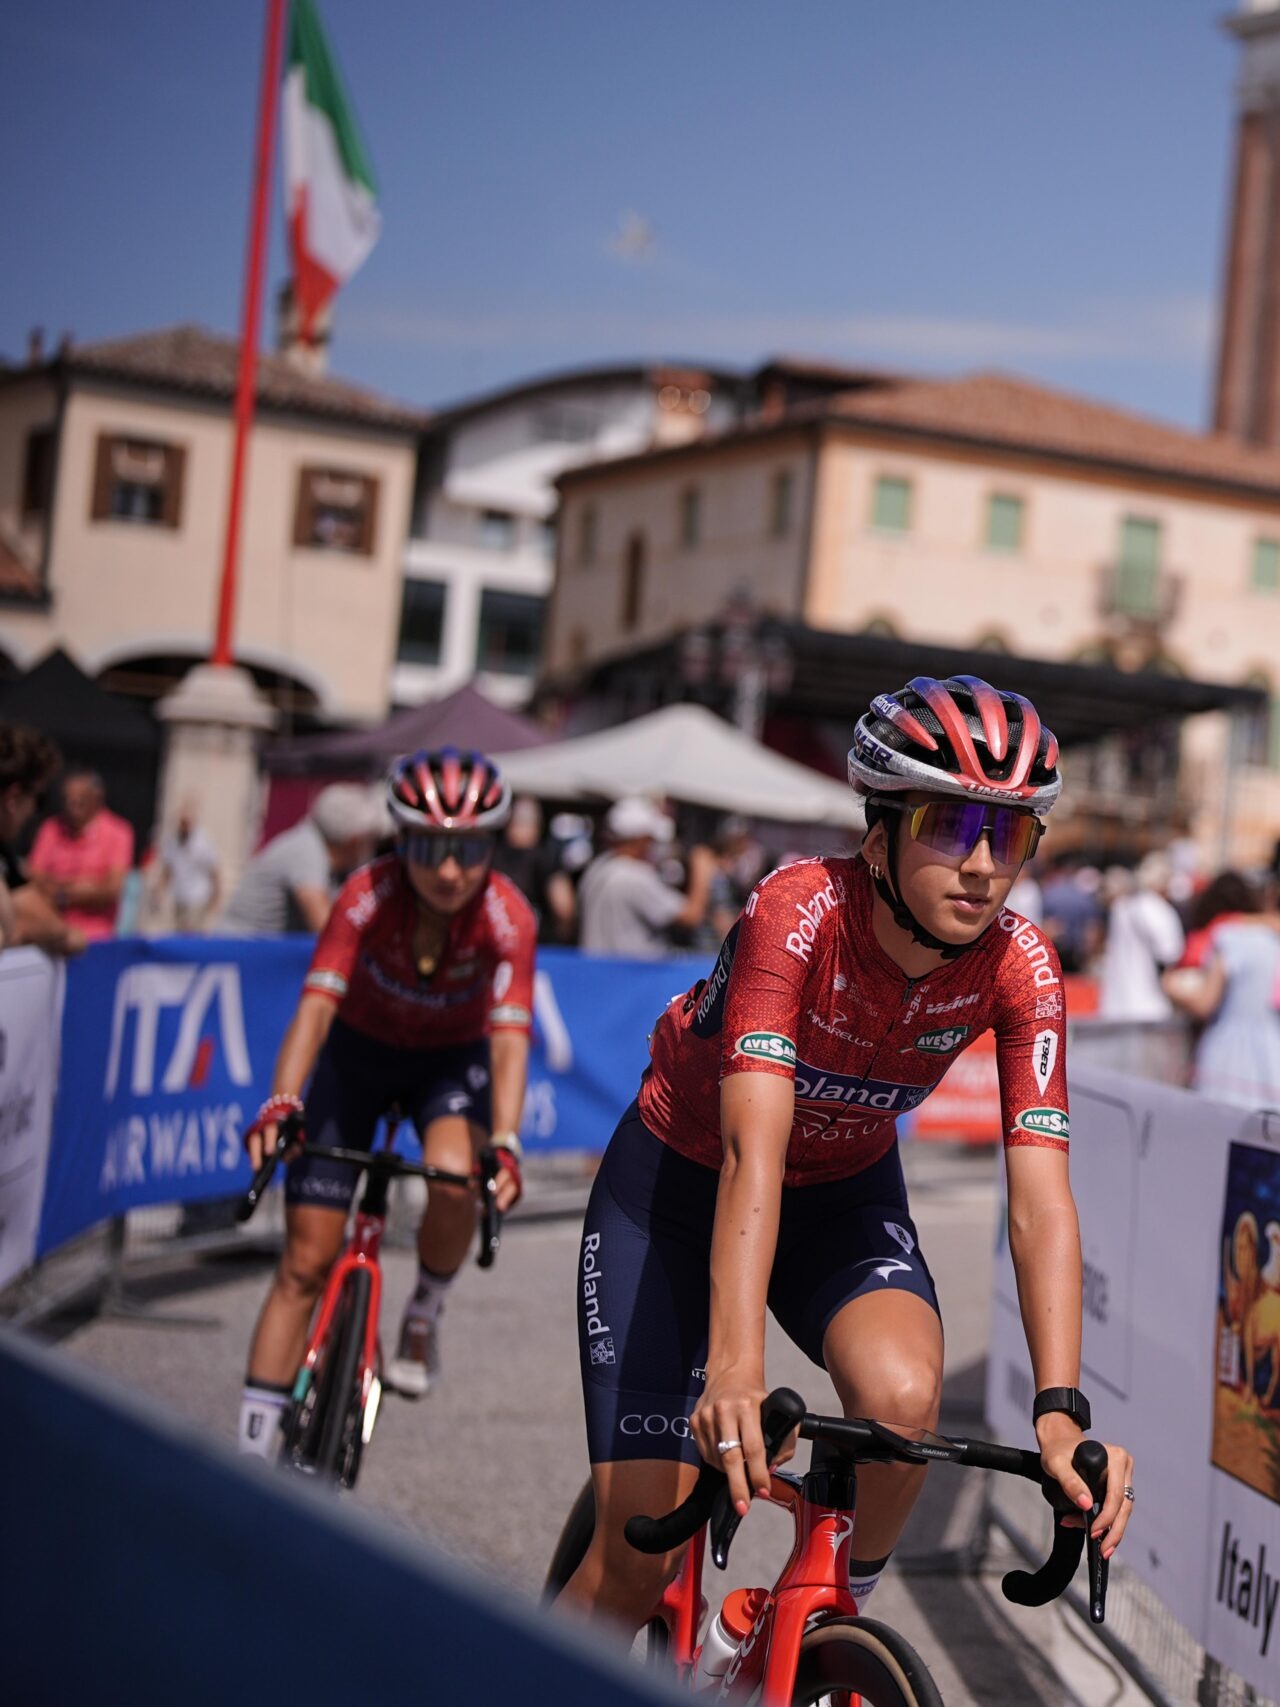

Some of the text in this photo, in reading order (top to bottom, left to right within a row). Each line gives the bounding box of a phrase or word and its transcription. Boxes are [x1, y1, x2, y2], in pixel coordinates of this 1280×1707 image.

[786, 877, 839, 963] Roland
[104, 962, 252, 1101] ITA
[101, 1102, 243, 1191] AIRWAYS
[583, 1231, 611, 1337] Roland
[620, 1414, 696, 1440] COG
[1216, 1520, 1280, 1657] Italy
